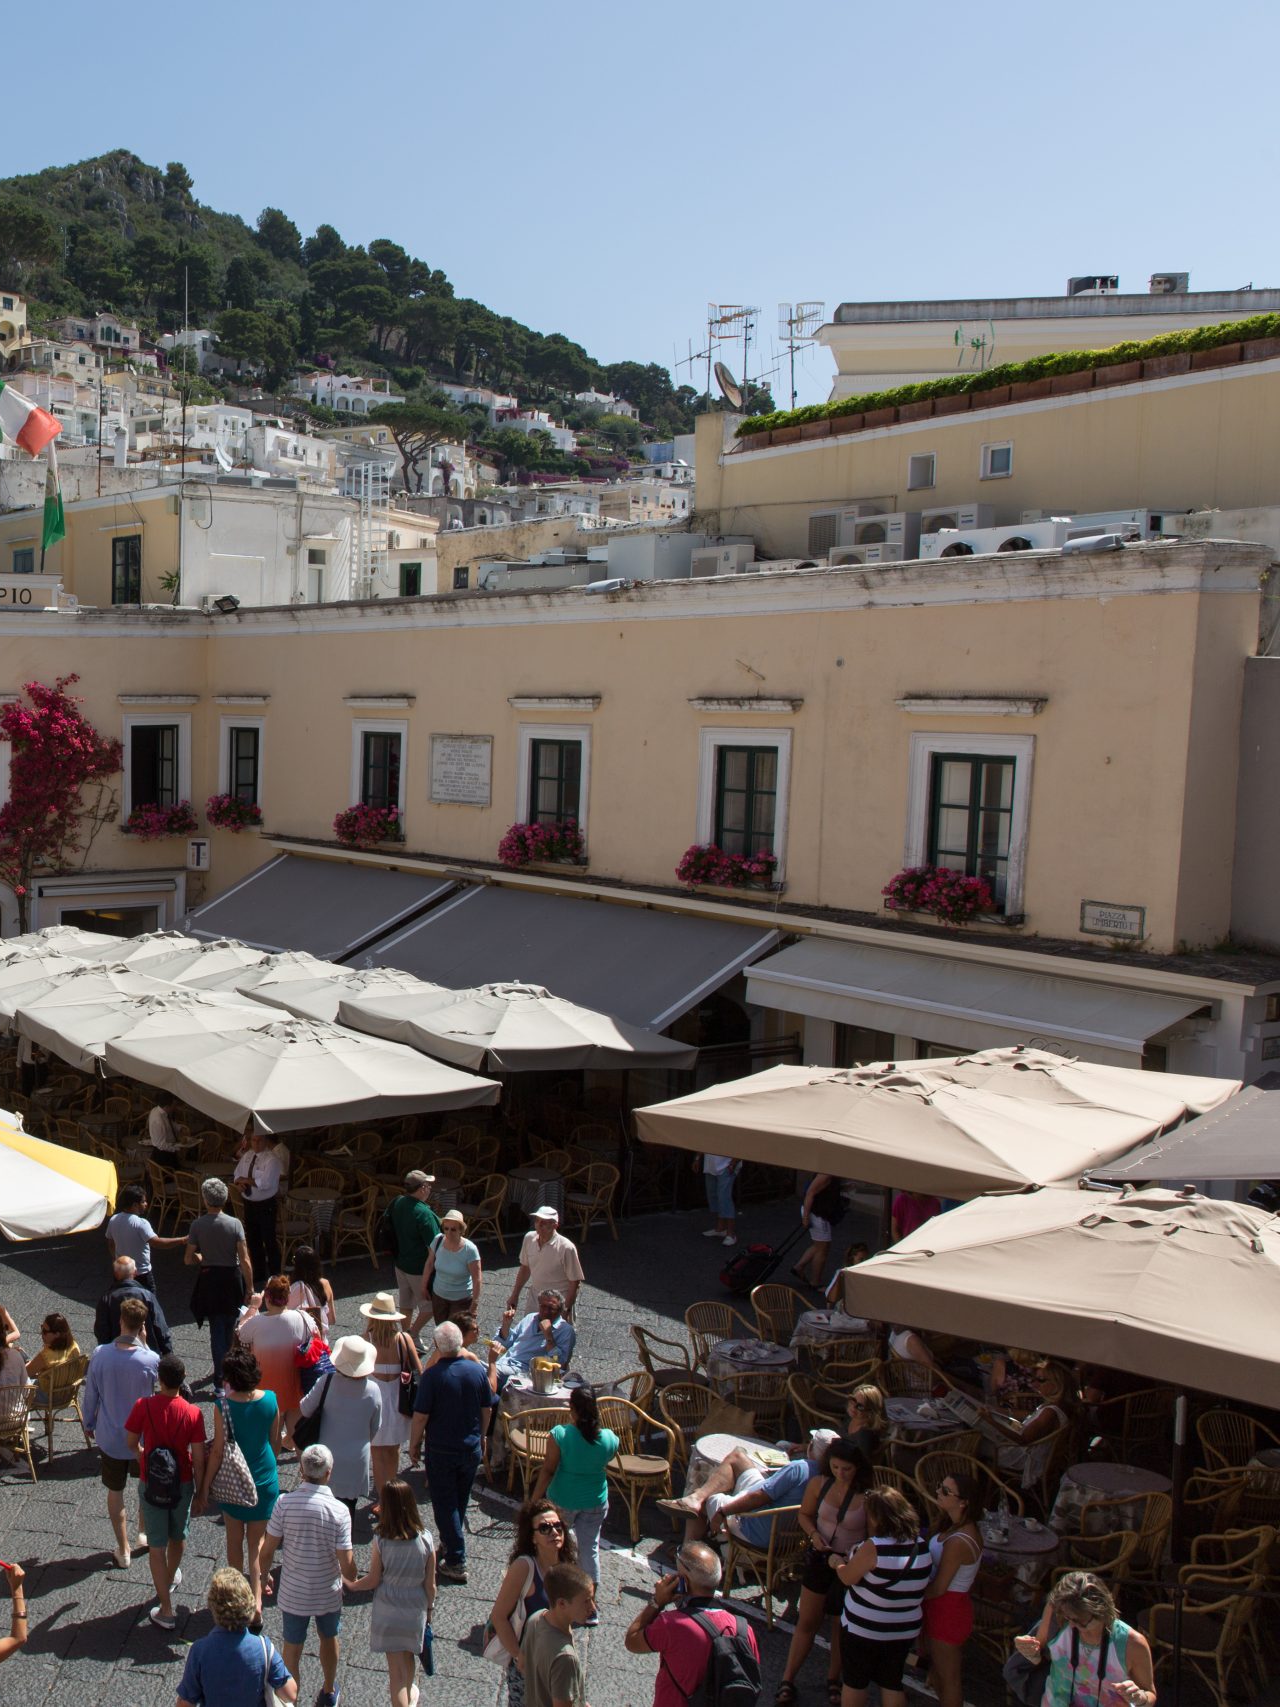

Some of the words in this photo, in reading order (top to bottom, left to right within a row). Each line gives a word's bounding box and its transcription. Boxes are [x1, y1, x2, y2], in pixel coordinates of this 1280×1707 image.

[191, 842, 206, 866] T
[1099, 910, 1126, 921] PIAZZA
[1092, 918, 1127, 929] UMBERTO
